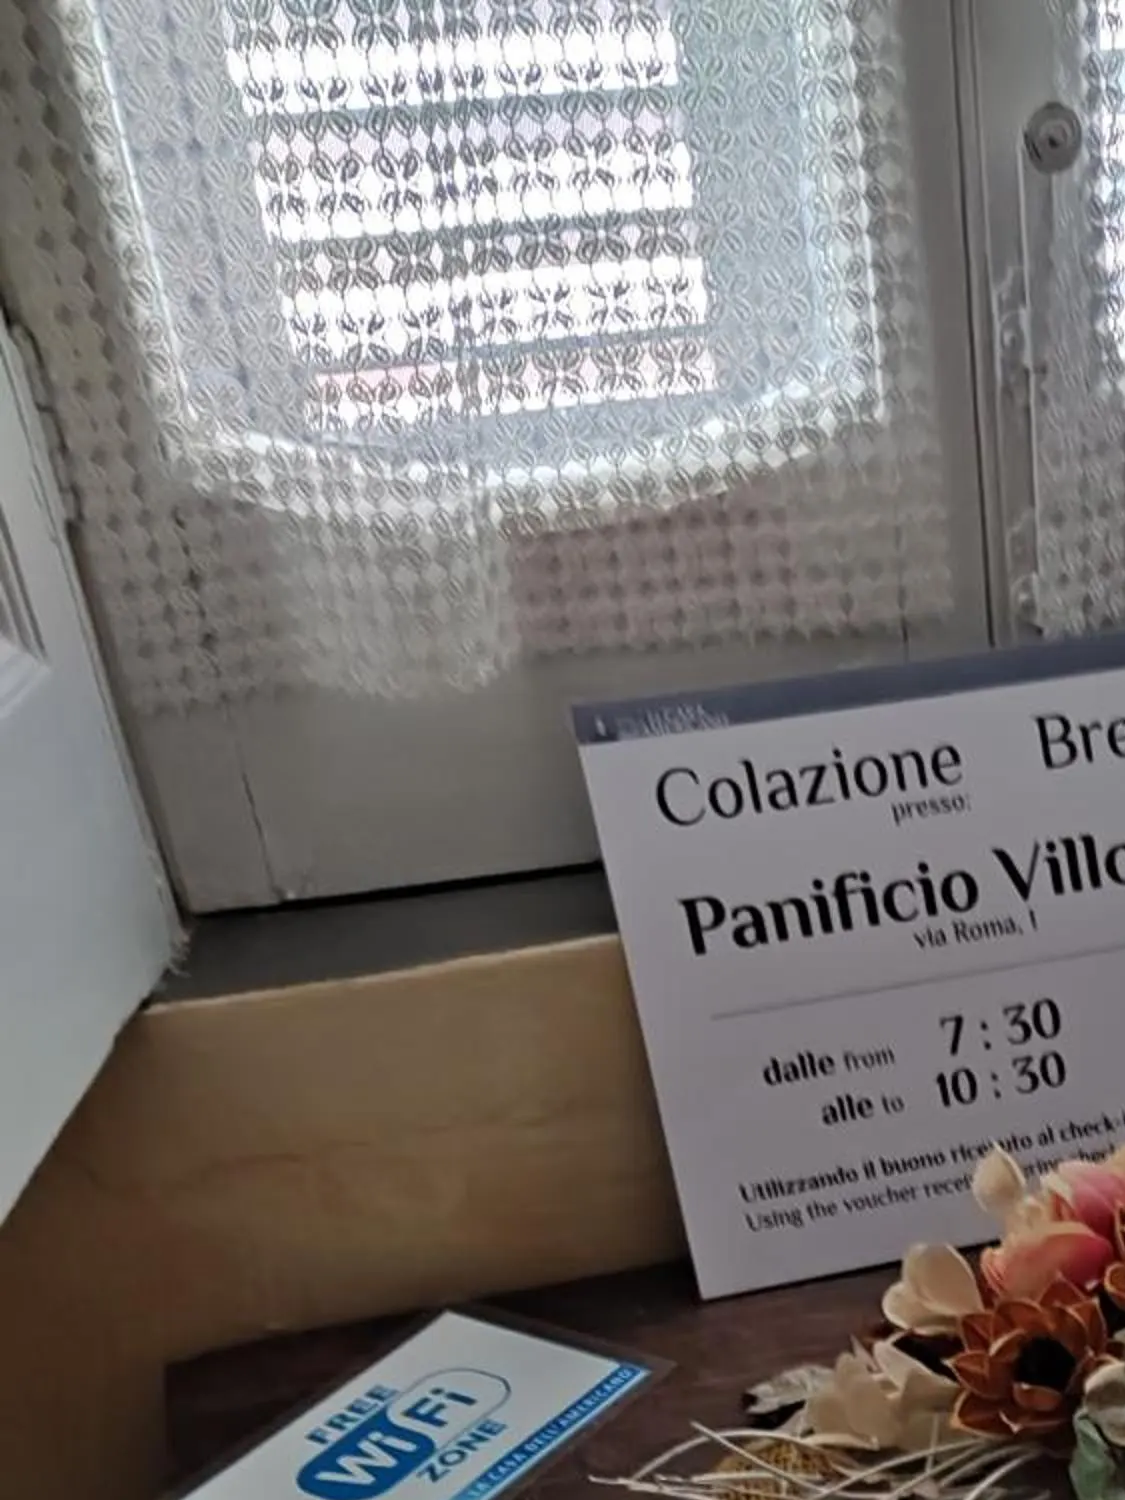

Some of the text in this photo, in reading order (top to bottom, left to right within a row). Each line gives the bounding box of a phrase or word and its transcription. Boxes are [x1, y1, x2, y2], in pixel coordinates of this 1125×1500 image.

[655, 741, 963, 826] Colazione
[891, 793, 971, 826] presso:
[679, 862, 978, 956] Panificio
[912, 922, 947, 948] via
[952, 914, 1023, 943] Roma,
[763, 1050, 835, 1086] dalle
[843, 1045, 896, 1072] from
[822, 1093, 874, 1125] alle
[881, 1095, 905, 1115] to
[738, 1166, 859, 1204] Utilizzando
[862, 1160, 877, 1181] il
[879, 1150, 946, 1177] buono
[1038, 1124, 1054, 1146] al
[745, 1206, 804, 1233] Using
[806, 1199, 838, 1221] the
[843, 1183, 917, 1213] voucher
[305, 1384, 398, 1445] FREE
[416, 1418, 507, 1483] ZONE
